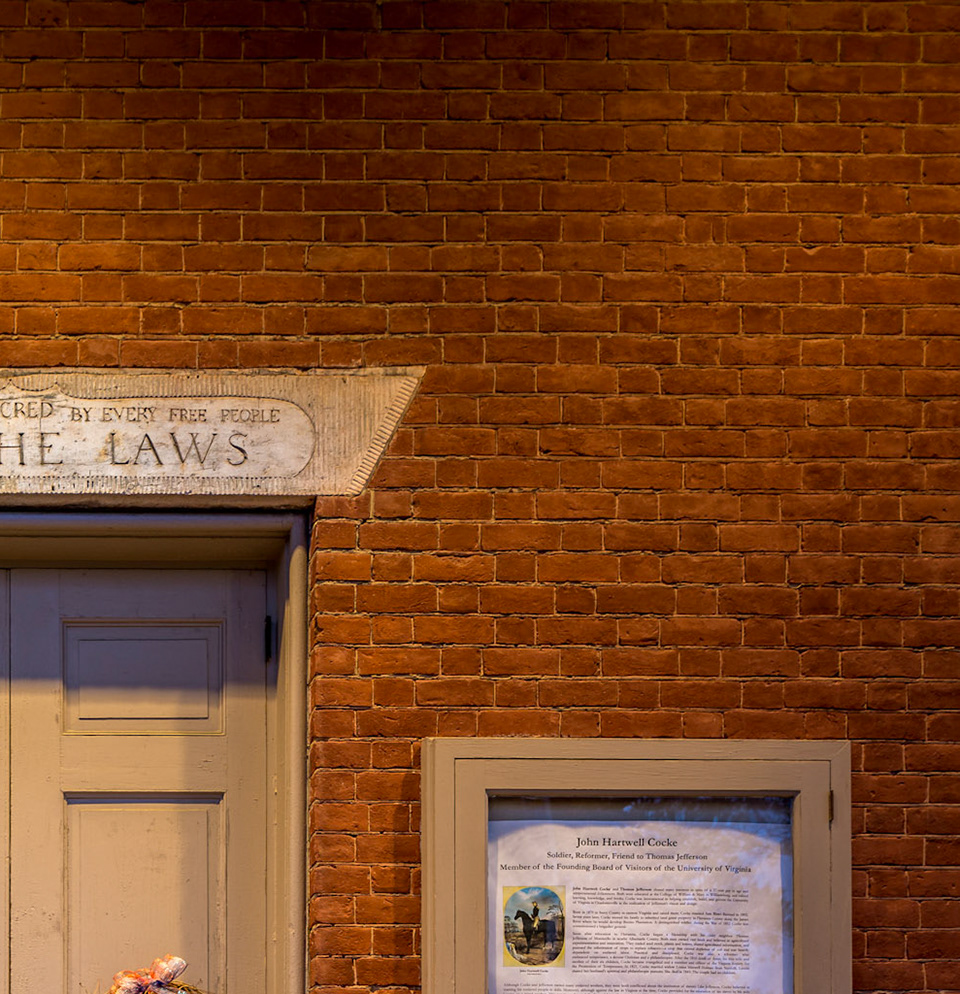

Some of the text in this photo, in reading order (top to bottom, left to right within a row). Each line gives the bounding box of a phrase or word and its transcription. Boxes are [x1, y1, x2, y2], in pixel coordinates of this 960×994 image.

[71, 407, 93, 422] BY
[101, 407, 158, 422] EVERY
[169, 408, 207, 422] FREE
[220, 408, 281, 423] PEOPLE
[109, 432, 249, 466] LAWS
[575, 837, 678, 848] John Hartwell Cocke
[546, 851, 574, 861] Soldier,
[575, 852, 611, 861] Reformer,
[612, 852, 636, 860] Friend
[645, 852, 675, 860] Thomas
[676, 852, 708, 861] Jefferson
[532, 863, 540, 871] of
[556, 864, 590, 872] Founding
[615, 864, 623, 872] of
[625, 864, 652, 872] Visitors
[653, 864, 662, 872] of
[677, 865, 713, 874] University
[725, 865, 752, 874] Virginia
